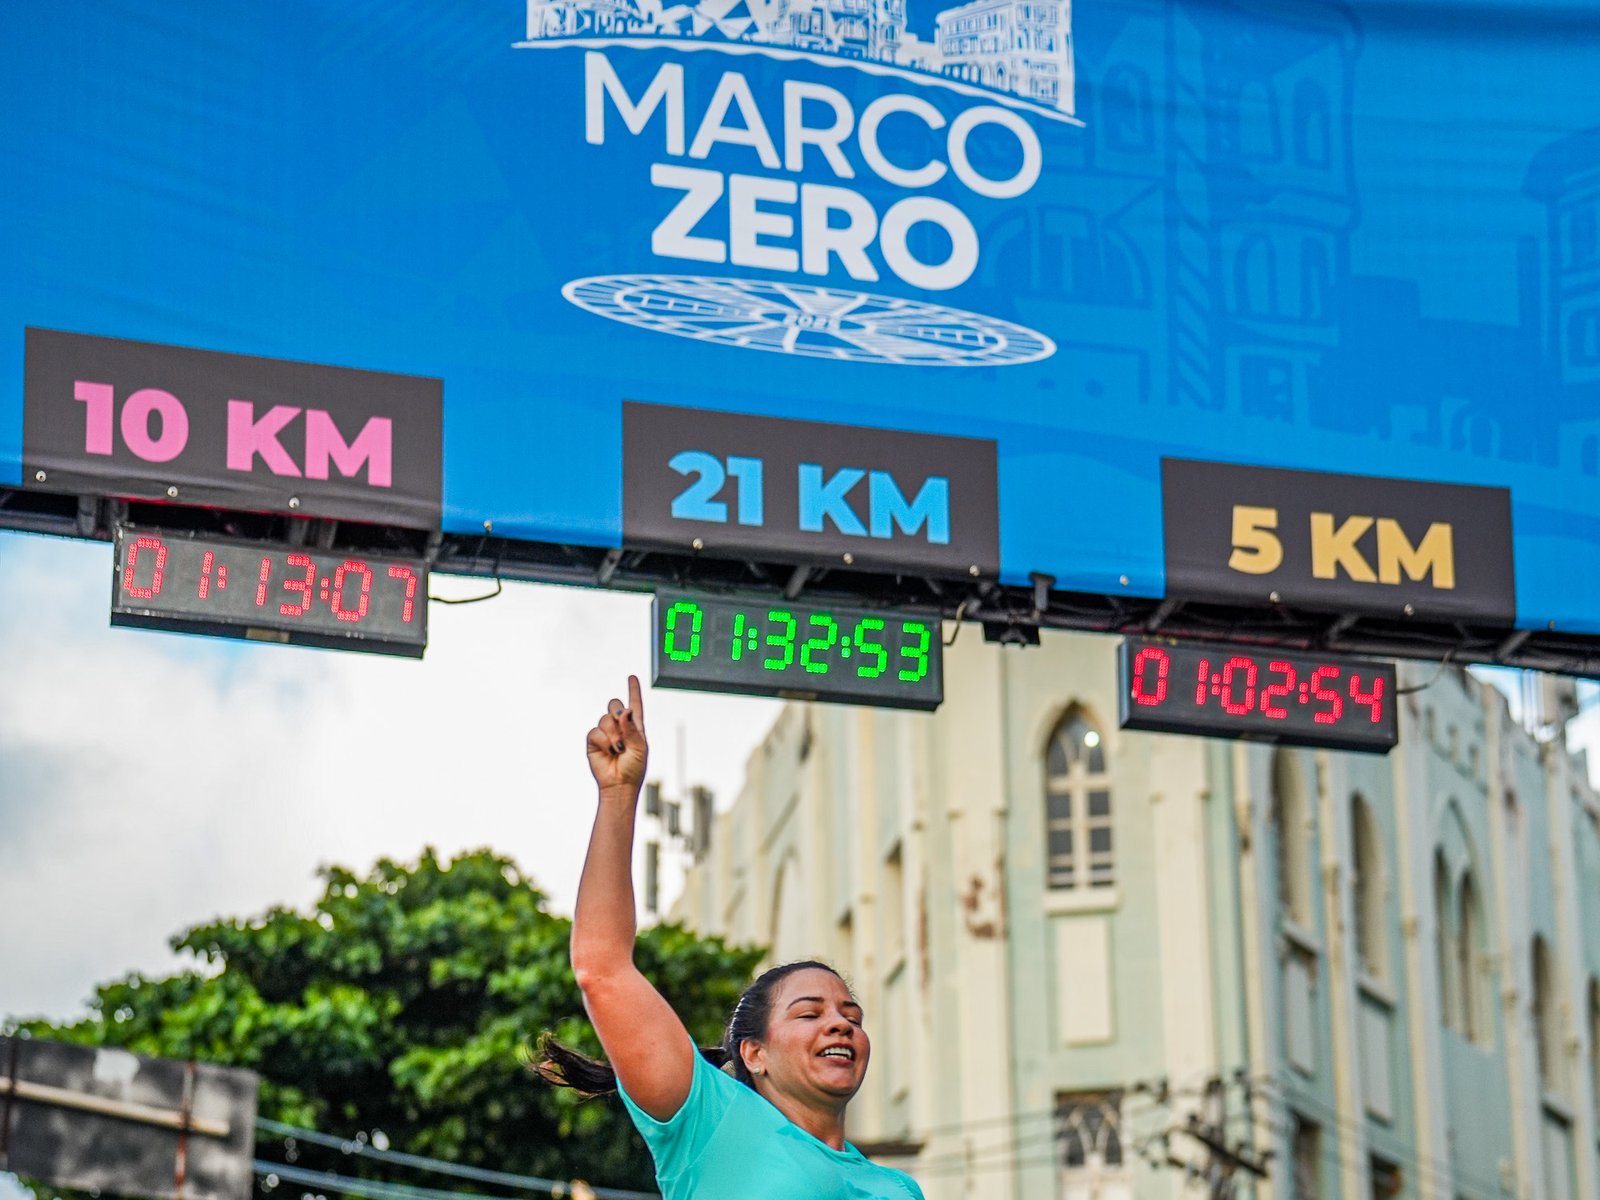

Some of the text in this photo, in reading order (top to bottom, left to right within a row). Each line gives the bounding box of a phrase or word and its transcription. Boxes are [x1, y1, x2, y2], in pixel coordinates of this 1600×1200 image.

[585, 52, 1042, 198] MARCO
[651, 164, 979, 290] ZERO
[74, 381, 392, 487] 10 KM
[668, 451, 950, 544] 21 KM
[123, 537, 417, 623] 01:13:07
[1229, 506, 1454, 589] 5 KM
[664, 602, 930, 682] 01:32:53
[1131, 647, 1384, 724] 01:02:54
